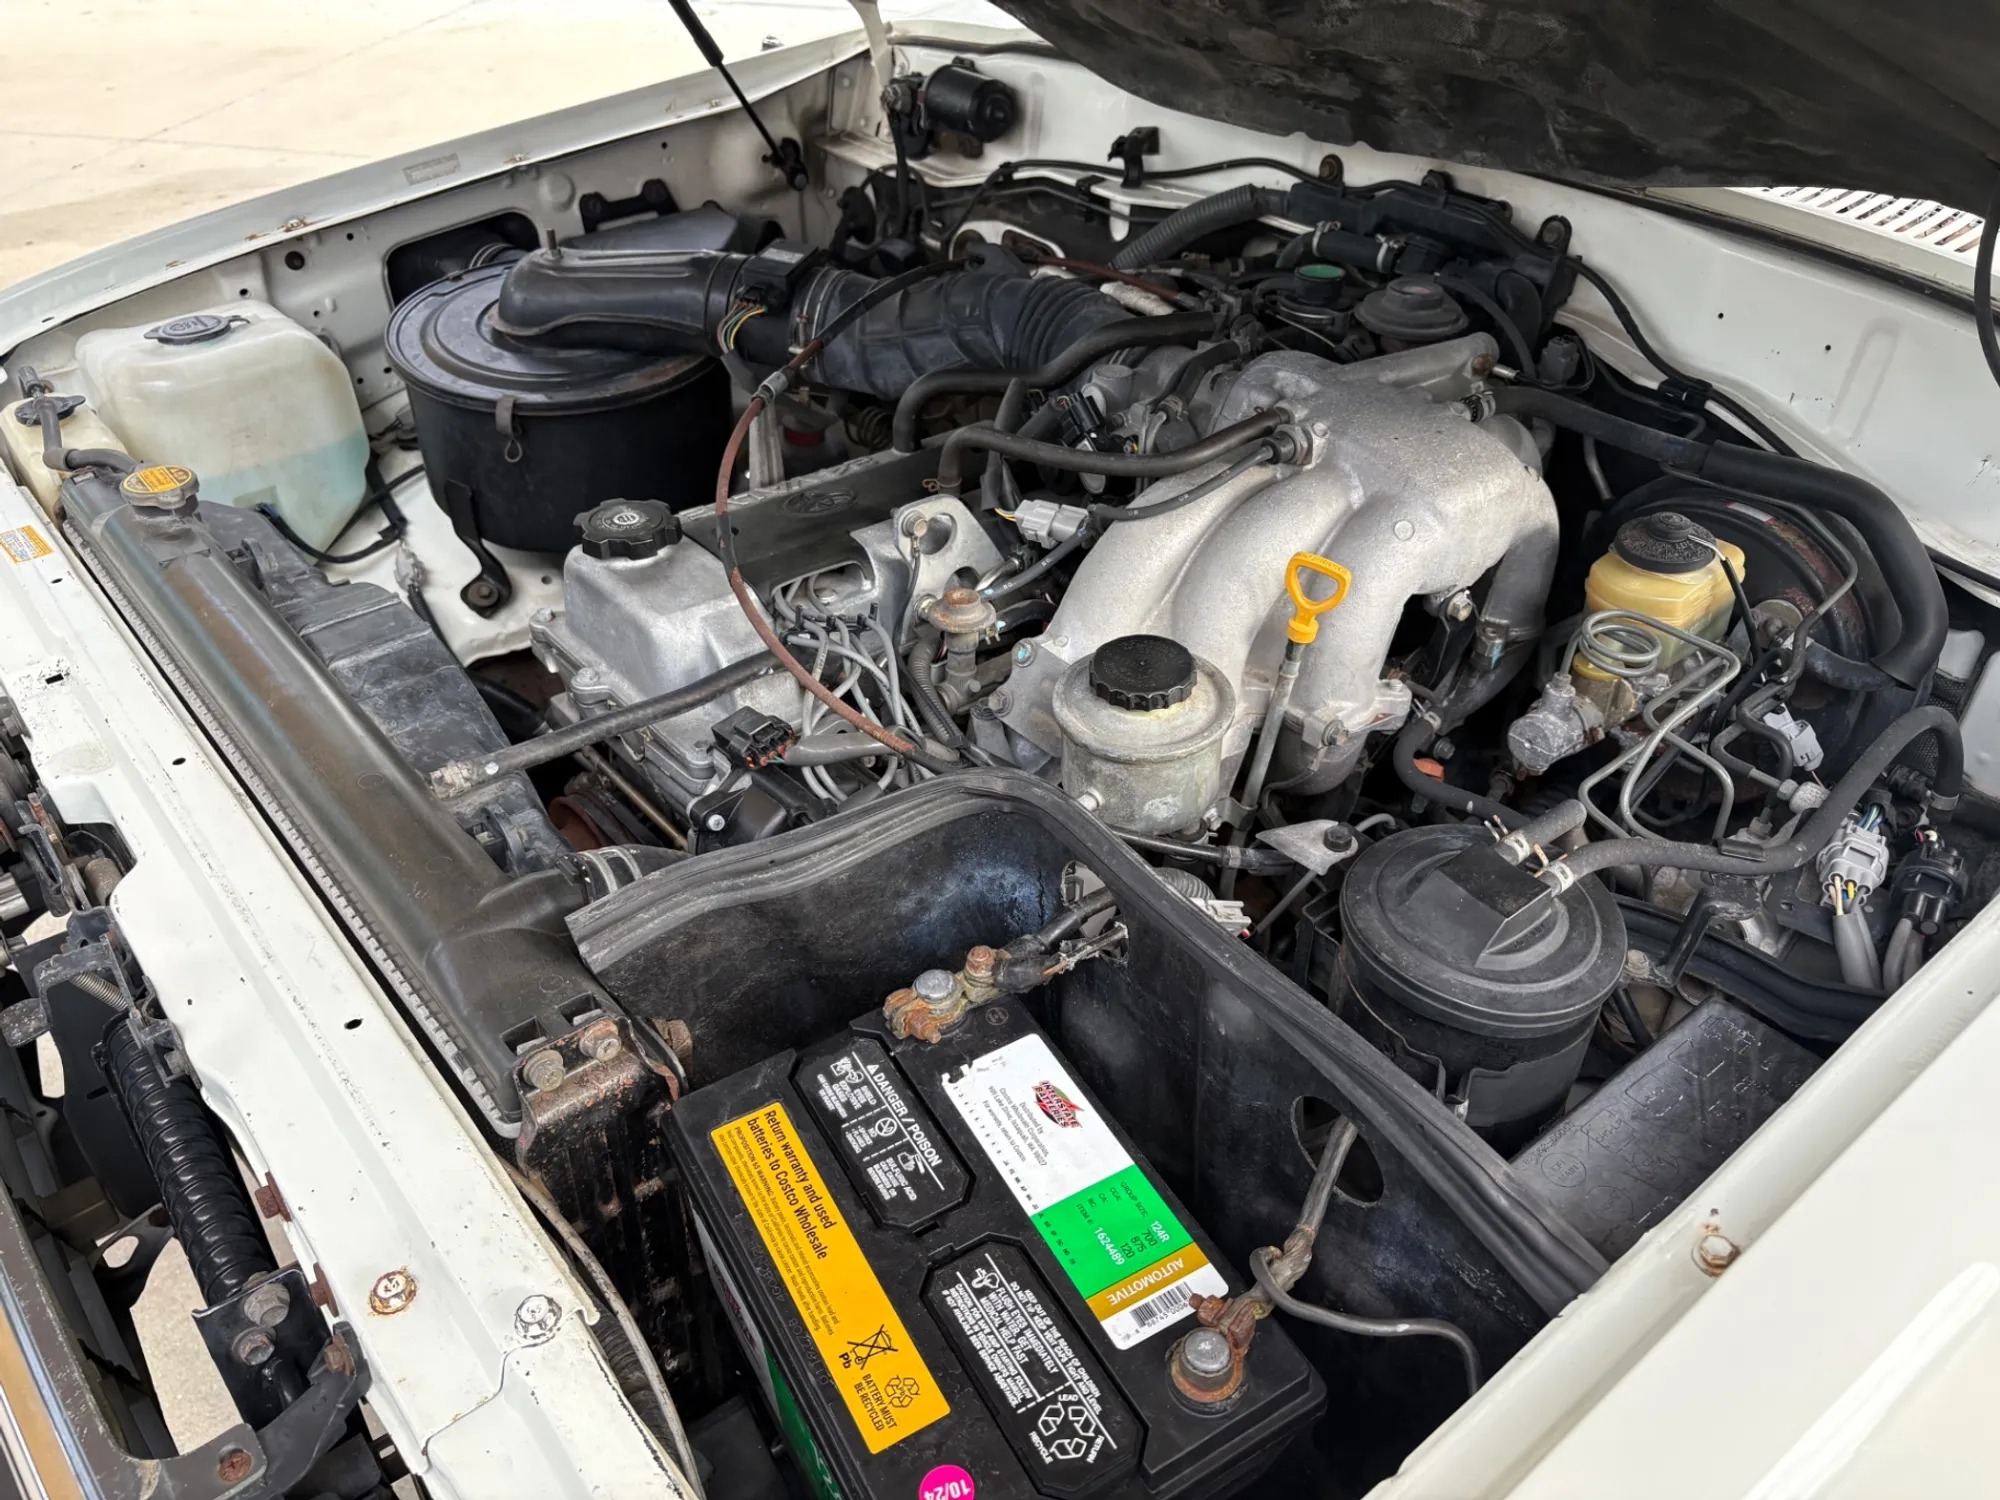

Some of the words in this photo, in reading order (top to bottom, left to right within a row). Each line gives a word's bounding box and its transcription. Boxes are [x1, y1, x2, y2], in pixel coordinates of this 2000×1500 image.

[831, 1082, 847, 1103] GASES
[838, 1079, 861, 1110] EXPLOSIVE
[853, 1087, 866, 1104] EYES
[860, 1084, 877, 1105] SHIELD
[981, 1099, 991, 1108] For
[1034, 1085, 1069, 1128] BATTERIES
[1040, 1080, 1079, 1127] INTERSTATE
[763, 1109, 789, 1142] Return
[867, 1127, 878, 1138] NO
[873, 1071, 909, 1117] DANGER
[907, 1122, 942, 1168] POISON
[993, 1094, 1005, 1107] Lake
[1000, 1105, 1014, 1120] Drive,
[1008, 1118, 1030, 1143] Issaquah,
[1026, 1141, 1036, 1151] WA
[1032, 1150, 1047, 1166] 98027
[998, 1087, 1015, 1105] Costco
[1010, 1103, 1031, 1128] Wholesale
[1025, 1127, 1050, 1157] Corporation,
[1018, 1101, 1041, 1128] Distributed
[1035, 1126, 1045, 1134] by
[733, 1126, 756, 1162] PROPOSITION
[746, 1116, 778, 1160] batteries
[752, 1161, 760, 1169] 65
[768, 1158, 783, 1171] to
[777, 1141, 812, 1185] warranty
[879, 1160, 889, 1172] CAN
[885, 1170, 899, 1187] CAUSE
[885, 1156, 908, 1187] SULFURIC
[903, 1184, 917, 1202] ACID
[755, 1169, 774, 1196] WARNING:
[774, 1169, 802, 1206] Costco
[802, 1181, 823, 1203] and
[812, 1201, 837, 1229] used
[1097, 1192, 1108, 1203] CA:
[1129, 1235, 1147, 1253] 875
[1119, 1181, 1137, 1202] GROUP
[1134, 1201, 1149, 1217] SIZE:
[1149, 1220, 1170, 1242] 124R
[792, 1204, 831, 1260] Wholesale
[1075, 1203, 1090, 1219] ITEM
[1092, 1226, 1125, 1265] 1624489
[1119, 1242, 1135, 1258] 120
[1140, 1228, 1158, 1247] 700
[1105, 1256, 1186, 1306] AUTOMOTIVE
[947, 1287, 976, 1325] INSTRUCTIONS
[987, 1291, 1004, 1311] WITH
[999, 1309, 1022, 1337] WATER.
[1016, 1335, 1032, 1351] GET
[944, 1295, 956, 1308] NOT
[951, 1307, 974, 1335] AVAILABLE
[968, 1334, 983, 1350] SEEK
[977, 1348, 997, 1373] SERVICE
[971, 1323, 981, 1332] IN
[975, 1331, 994, 1354] VEHICLE
[978, 1295, 1004, 1327] MEDICAL
[998, 1325, 1016, 1346] HELP
[1010, 1344, 1029, 1365] FAST
[995, 1286, 1016, 1310] FLUSH
[1010, 1309, 1028, 1329] EYES
[1022, 1327, 1059, 1375] IMMEDIATELY
[1023, 1288, 1038, 1304] KEEP
[1033, 1303, 1046, 1317] OUT
[1042, 1315, 1053, 1326] OF
[1048, 1325, 1061, 1339] THE
[1057, 1337, 1074, 1358] REACH
[1070, 1357, 1081, 1368] OF
[1076, 1366, 1101, 1398] CHILDREN
[838, 1351, 854, 1369] Pb
[969, 1306, 982, 1319] FOR
[977, 1318, 991, 1334] SAFE
[986, 1332, 1001, 1349] JUMP
[996, 1347, 1018, 1376] STARTING
[1013, 1374, 1033, 1399] FOLLOW
[1009, 1280, 1020, 1291] DO
[1015, 1290, 1028, 1303] NOT
[1032, 1314, 1047, 1331] KEEP
[1042, 1329, 1057, 1346] VENT
[1053, 1345, 1068, 1362] CAPS
[1064, 1362, 1080, 1381] TIGHT
[1076, 1380, 1090, 1395] AND
[1085, 1394, 1103, 1415] LEVEL
[853, 1381, 865, 1394] BE
[861, 1373, 885, 1408] BATTERY
[878, 1405, 897, 1430] MUST
[858, 1392, 885, 1432] RECYCLED
[1027, 1430, 1054, 1464] RECYCLE
[1086, 1435, 1104, 1463] RETURN
[924, 1479, 971, 1500] 10/24
